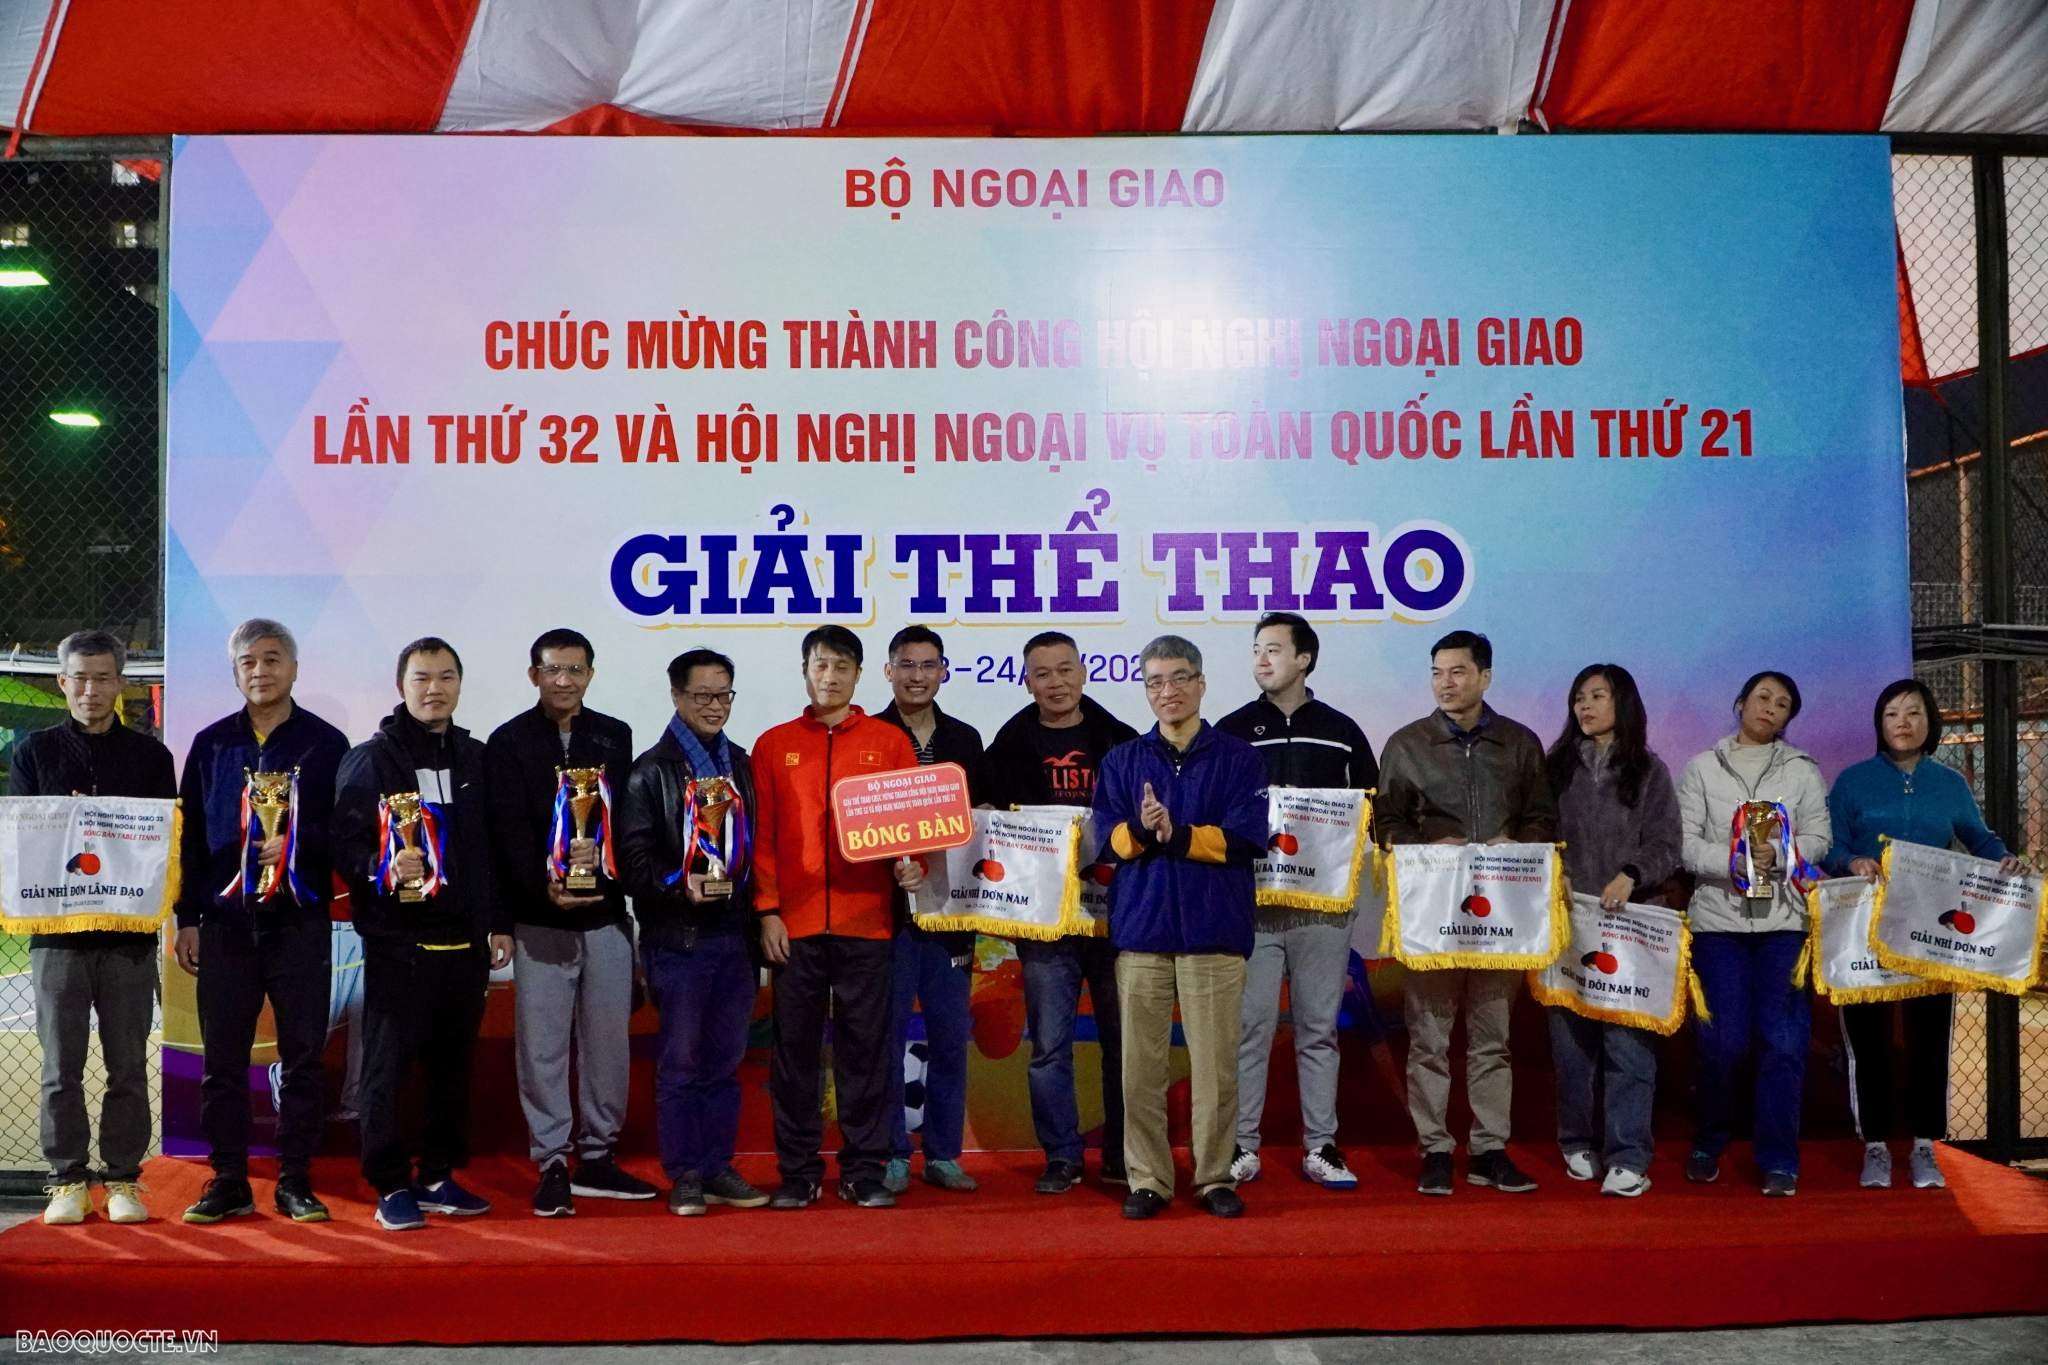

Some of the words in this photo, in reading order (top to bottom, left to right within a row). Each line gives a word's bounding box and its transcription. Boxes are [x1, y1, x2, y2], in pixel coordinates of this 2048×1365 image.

[845, 156, 911, 220] BỘ
[932, 168, 1088, 220] NGOẠI
[1108, 168, 1224, 208] GIAO
[484, 310, 609, 370] CHÚC
[627, 310, 767, 370] MỪNG
[783, 310, 937, 370] THÀNH
[954, 309, 1082, 369] CÔNG
[1097, 309, 1174, 380] HỘI
[1190, 318, 1301, 378] NGHỊ
[1318, 317, 1459, 377] NGOẠI
[1477, 317, 1583, 366] GIAO
[313, 397, 410, 465] LẦN
[427, 404, 528, 465] THỨ
[539, 413, 599, 465] 32
[615, 404, 680, 463] VÀ
[697, 403, 777, 475] HỘI
[797, 412, 916, 474] NGHỊ
[934, 412, 1087, 473] NGOẠI
[1103, 412, 1167, 471] VỤ
[1182, 401, 1312, 461] TOÀN
[1330, 393, 1462, 465] QUỐC
[1480, 392, 1574, 459] LẦN
[1590, 398, 1688, 459] THỨ
[1701, 408, 1753, 457] 21
[610, 503, 865, 616] GIẢI
[895, 488, 1120, 614] THỂ
[1152, 528, 1465, 612] THAO
[883, 777, 912, 789] NGOẠI
[914, 774, 937, 785] GIAO
[847, 822, 911, 850] BÓNG
[917, 813, 966, 840] BÀN
[1297, 866, 1316, 877] NAM
[21, 884, 45, 898] GIẢI
[48, 884, 67, 898] NHÌ
[88, 882, 117, 895] LÃNH
[119, 887, 144, 899] ĐẠO
[1005, 893, 1029, 905] NAM
[1439, 922, 1461, 936] GIẢI
[1490, 926, 1514, 937] NAM
[1910, 930, 1933, 944] GIẢI
[1979, 945, 1996, 957] NỮ
[1850, 956, 1874, 970] GIẢI
[1608, 984, 1632, 996] NAM
[1634, 986, 1651, 999] NỮ
